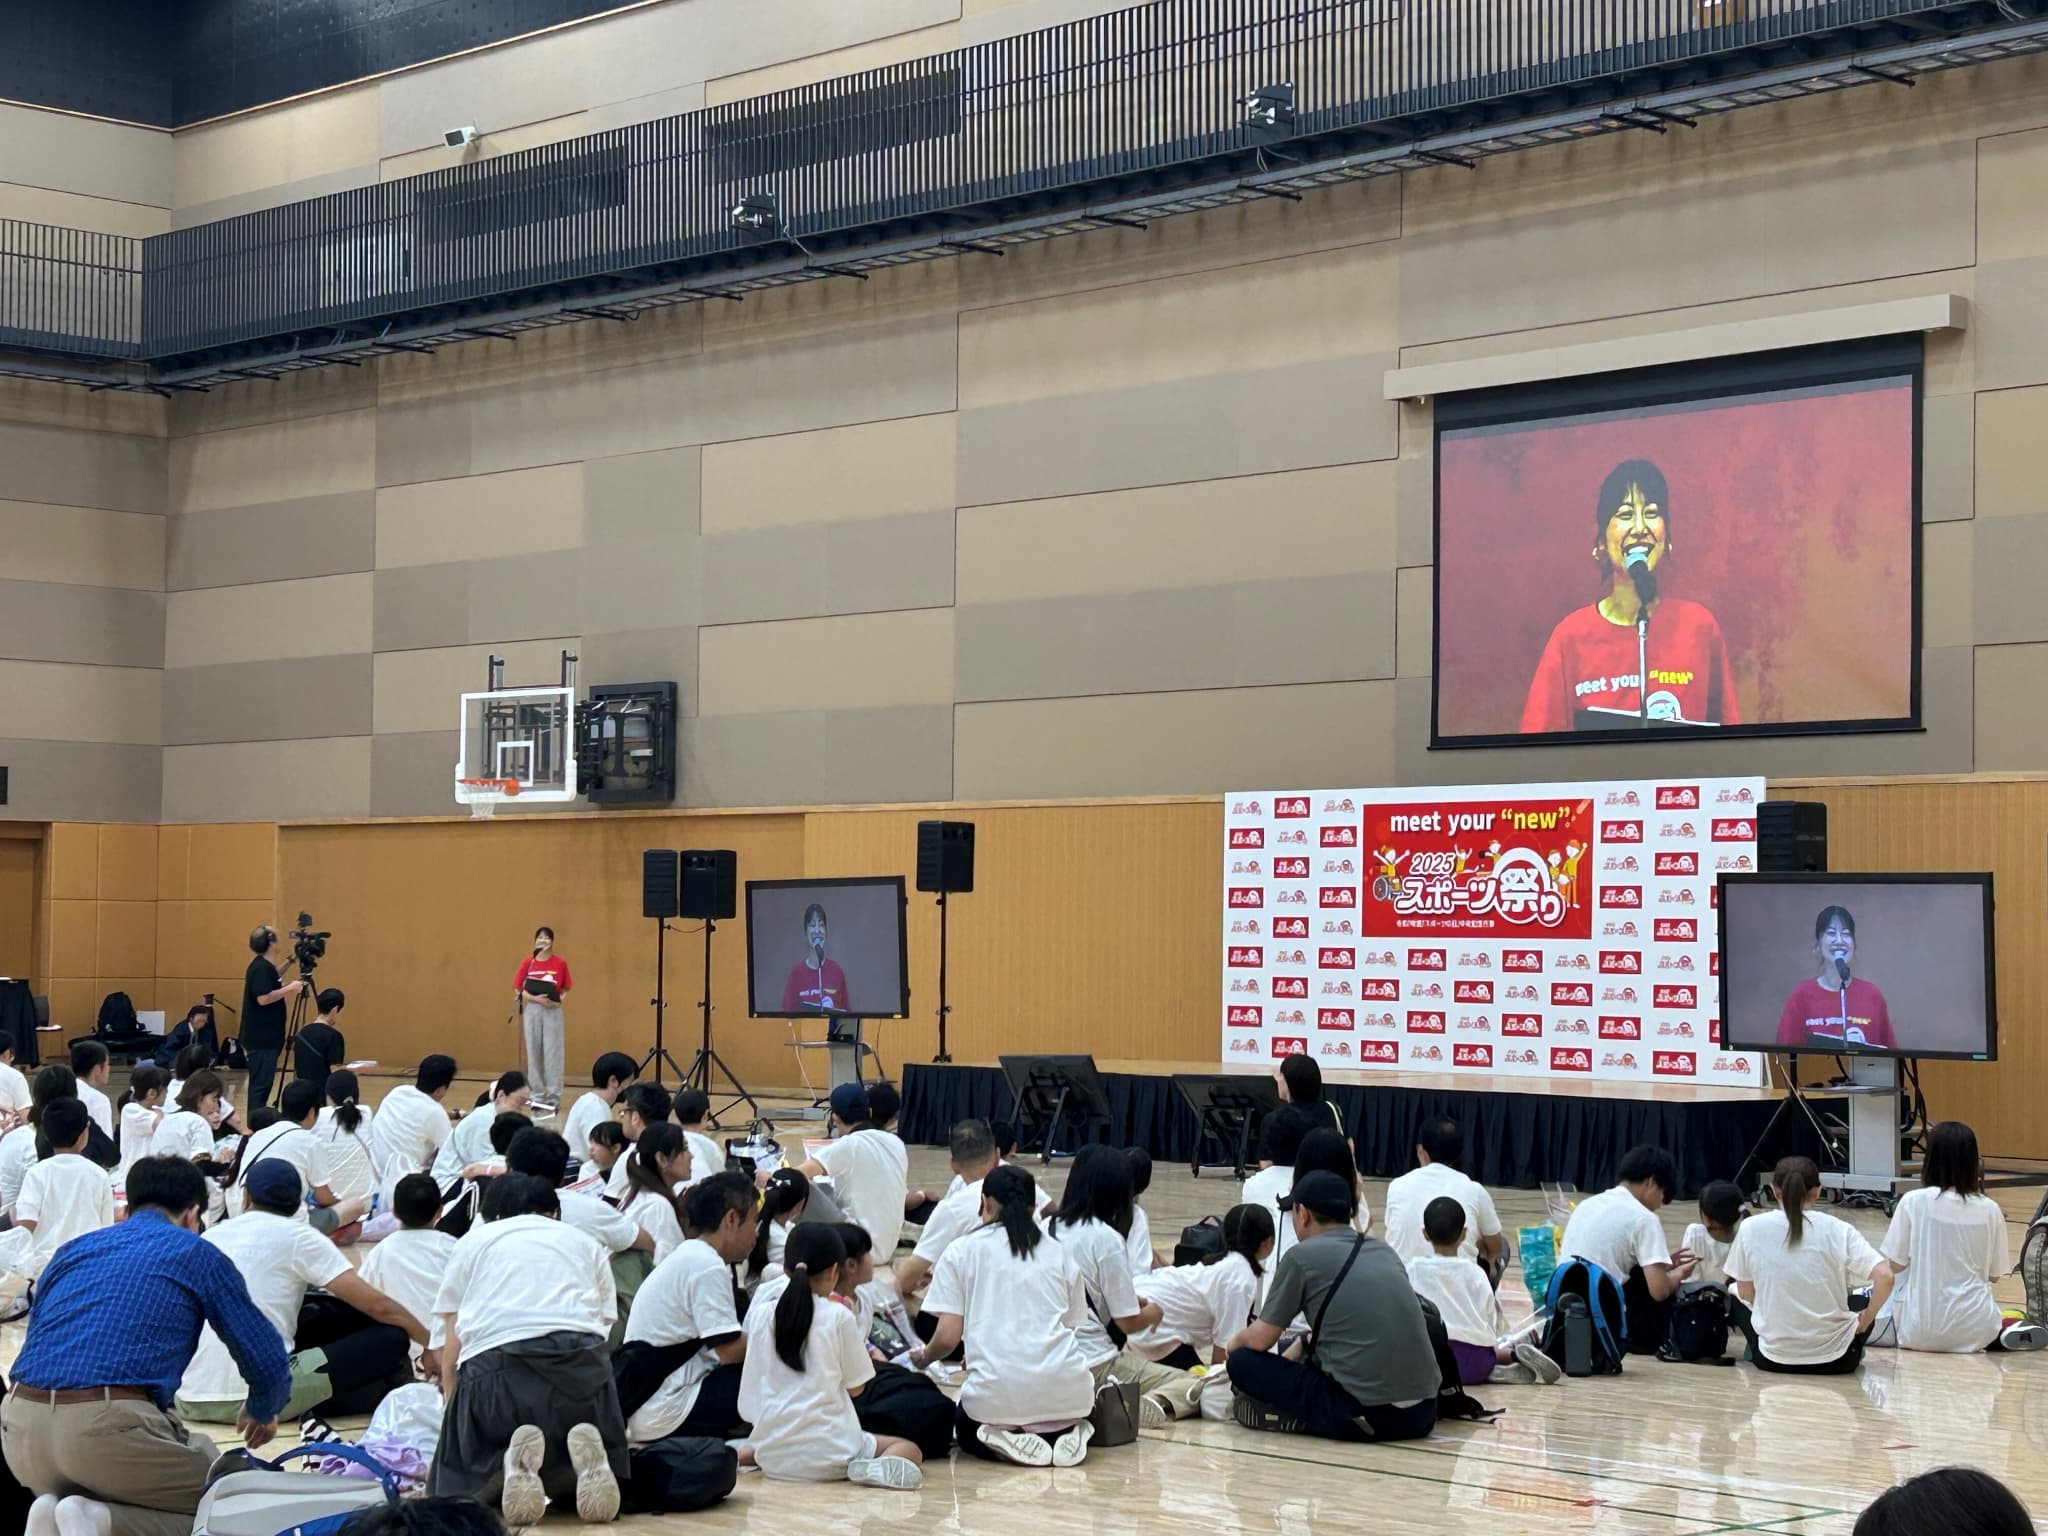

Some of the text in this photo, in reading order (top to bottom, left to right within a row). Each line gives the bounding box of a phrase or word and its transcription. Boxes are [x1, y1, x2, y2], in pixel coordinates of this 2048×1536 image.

[1610, 675, 1639, 692] you
[1390, 806, 1571, 836] meet your “new”
[1410, 852, 1455, 874] 2025
[1395, 867, 1564, 924] スポーツ祭り
